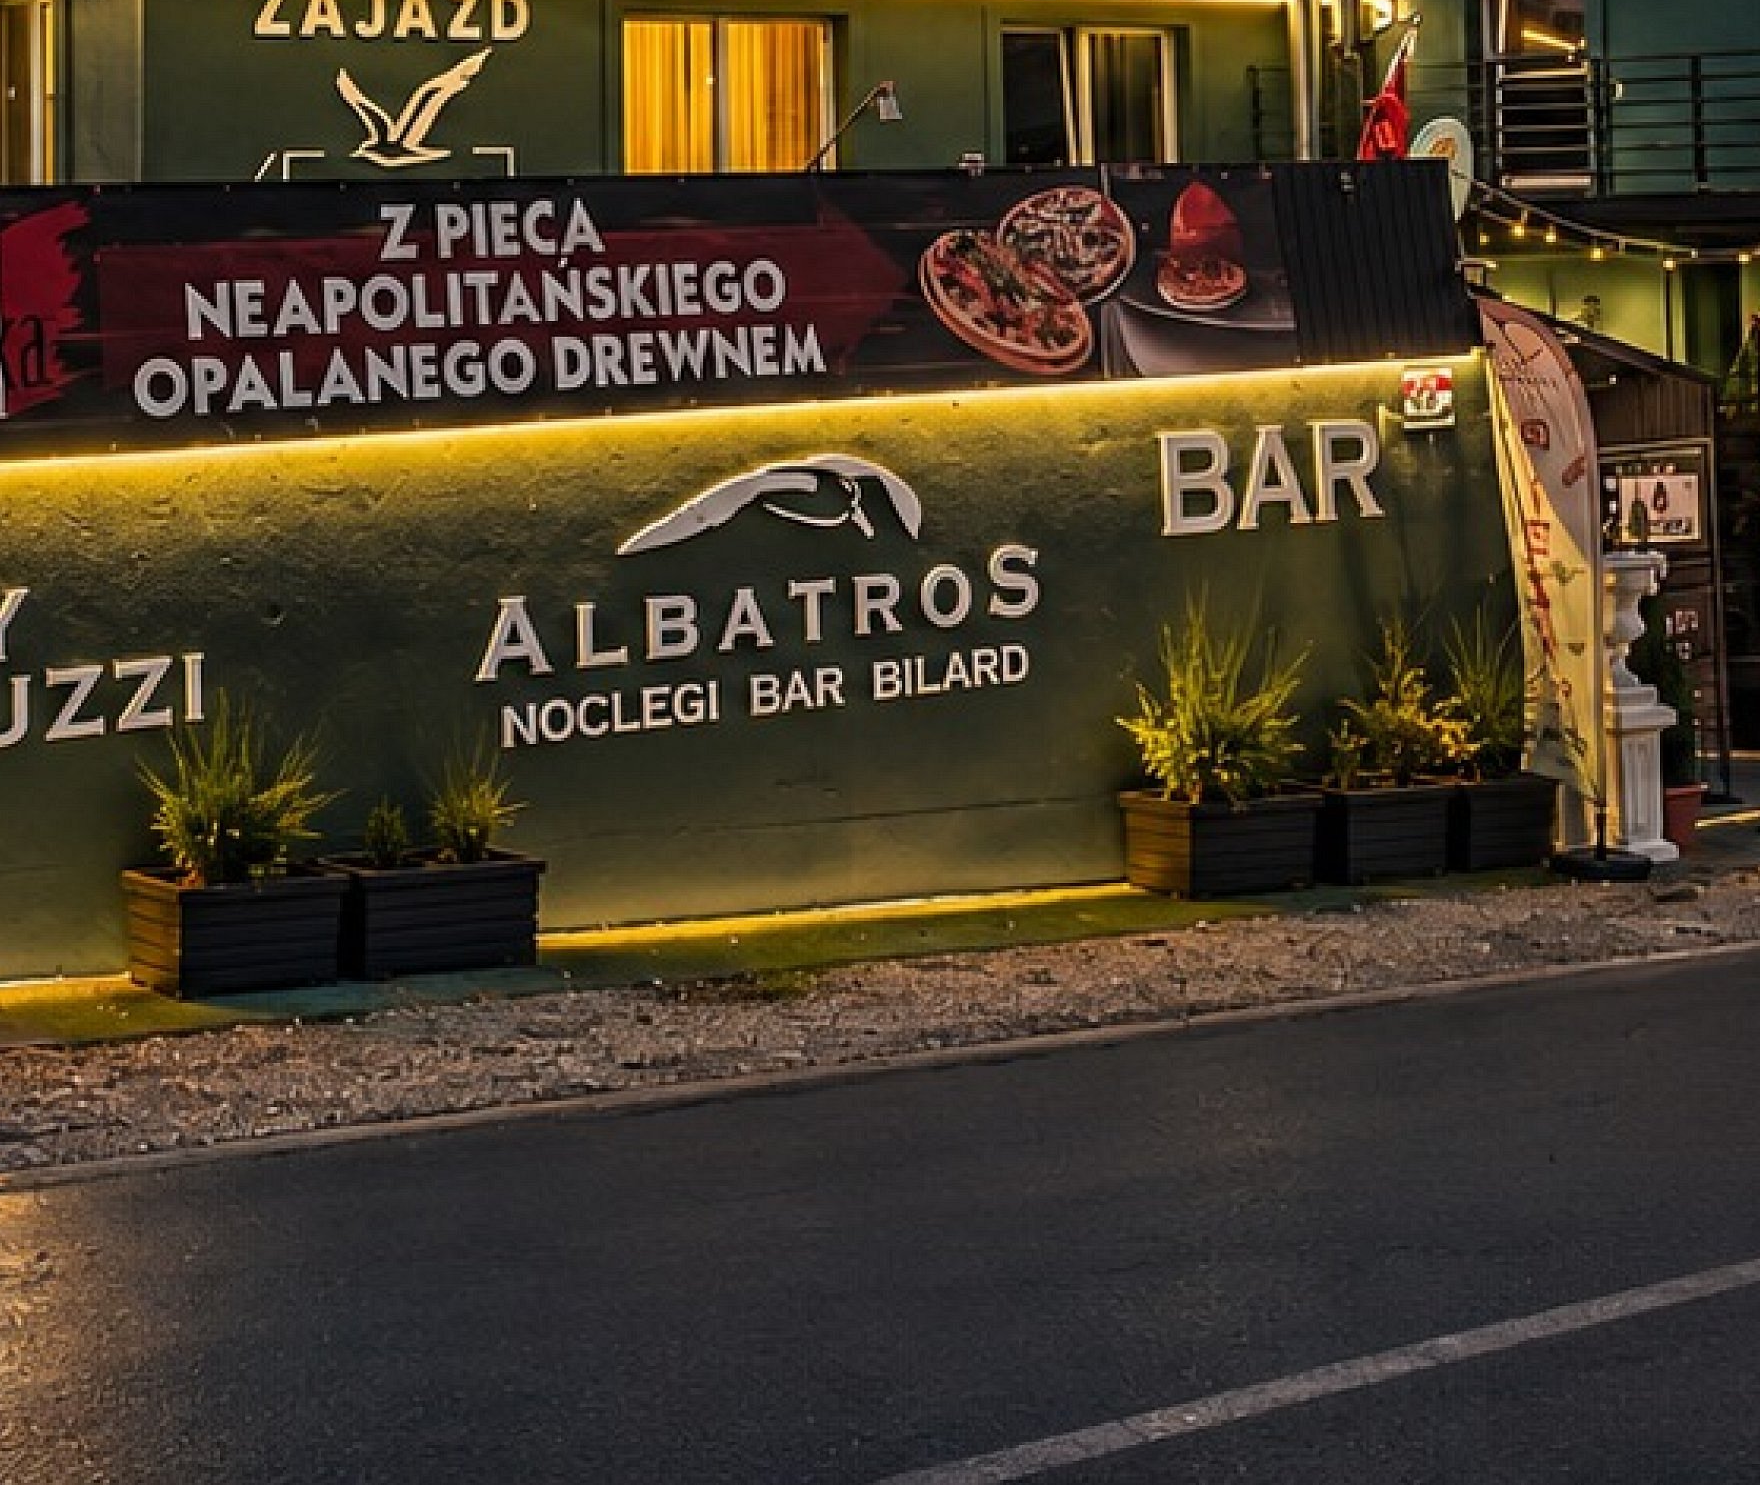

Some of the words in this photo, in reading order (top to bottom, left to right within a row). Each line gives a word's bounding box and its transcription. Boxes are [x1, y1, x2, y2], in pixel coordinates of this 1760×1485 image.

[379, 203, 418, 261] Z
[437, 197, 604, 260] PIECA
[184, 258, 787, 341] NEAPOLITAŃSKIEGO
[134, 340, 537, 417] OPALANEGO
[554, 323, 828, 391] DREWNEM
[1157, 418, 1385, 537] BAR
[476, 543, 1039, 681] ALBATROS
[500, 679, 720, 748] NOCLEGI
[749, 669, 844, 716] BAR
[873, 644, 1028, 700] BILARD
